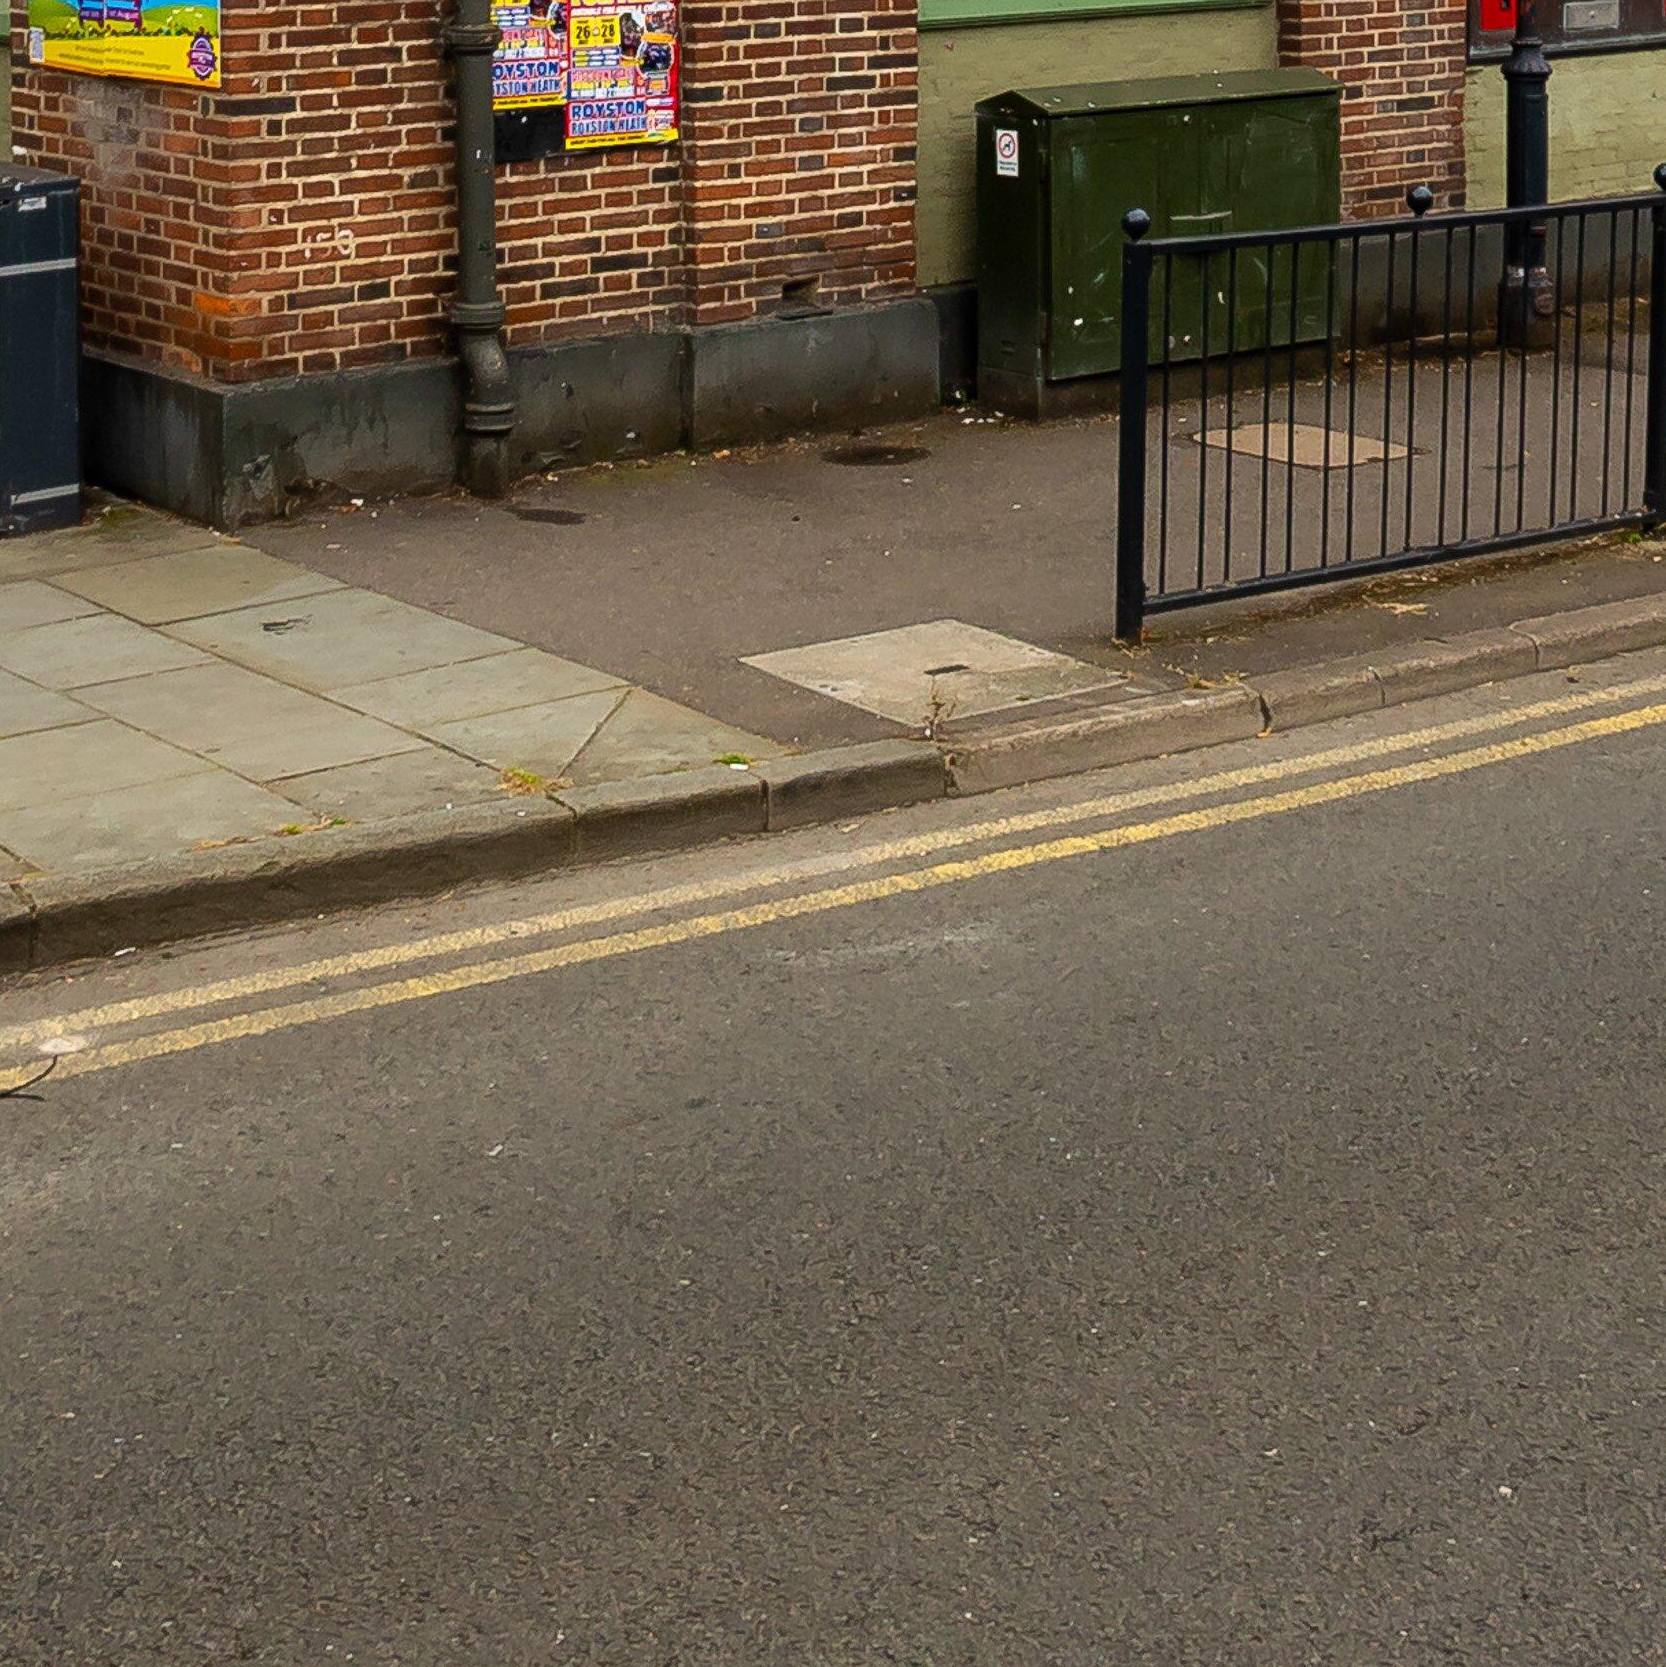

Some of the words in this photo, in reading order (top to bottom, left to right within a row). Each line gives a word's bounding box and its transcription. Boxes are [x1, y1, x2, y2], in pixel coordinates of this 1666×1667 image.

[576, 25, 591, 40] 26
[601, 23, 616, 38] 28
[493, 61, 559, 81] OYSTON
[493, 80, 529, 97] YSTON
[571, 99, 646, 120] ROYSTON
[571, 119, 616, 136] ROYSTON
